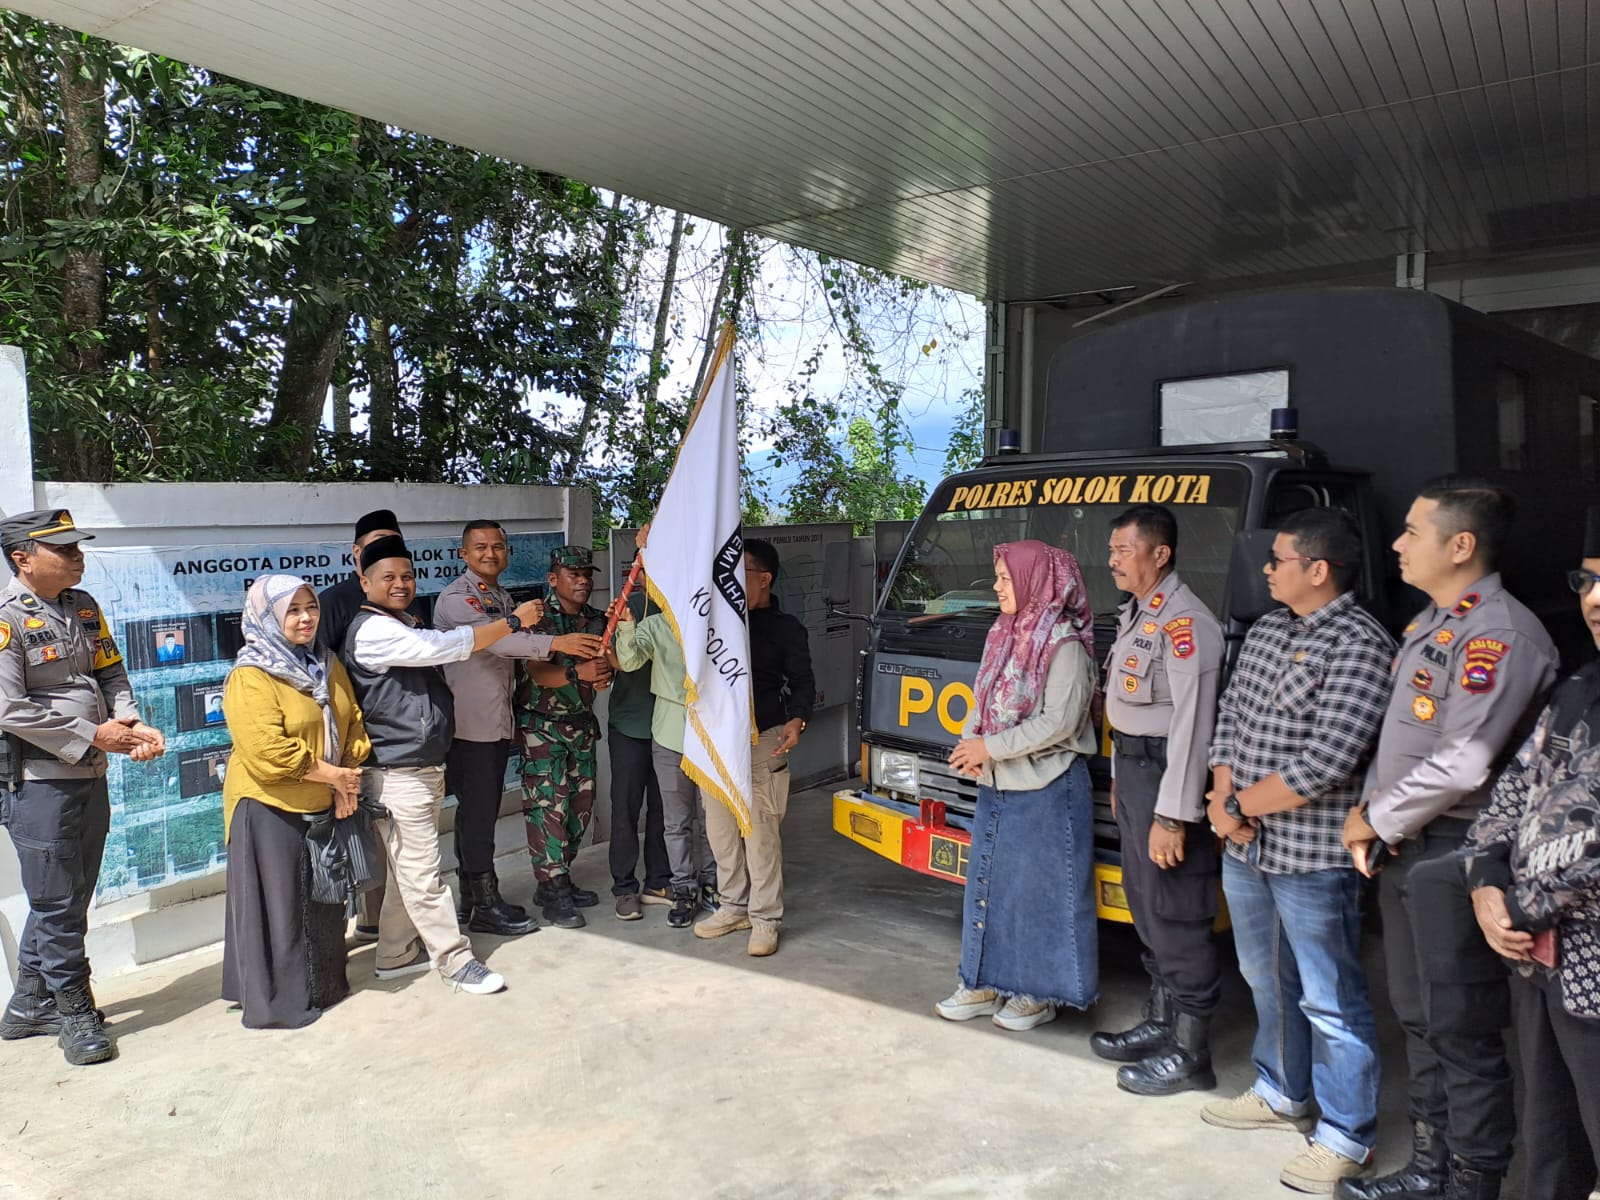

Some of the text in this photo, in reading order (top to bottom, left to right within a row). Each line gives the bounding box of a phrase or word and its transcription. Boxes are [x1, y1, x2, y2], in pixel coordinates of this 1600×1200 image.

[947, 475, 1211, 511] POLRES SOLOK KOTA
[173, 557, 273, 575] ANGGOTA
[279, 555, 330, 569] DPRD
[408, 549, 443, 562] LOK
